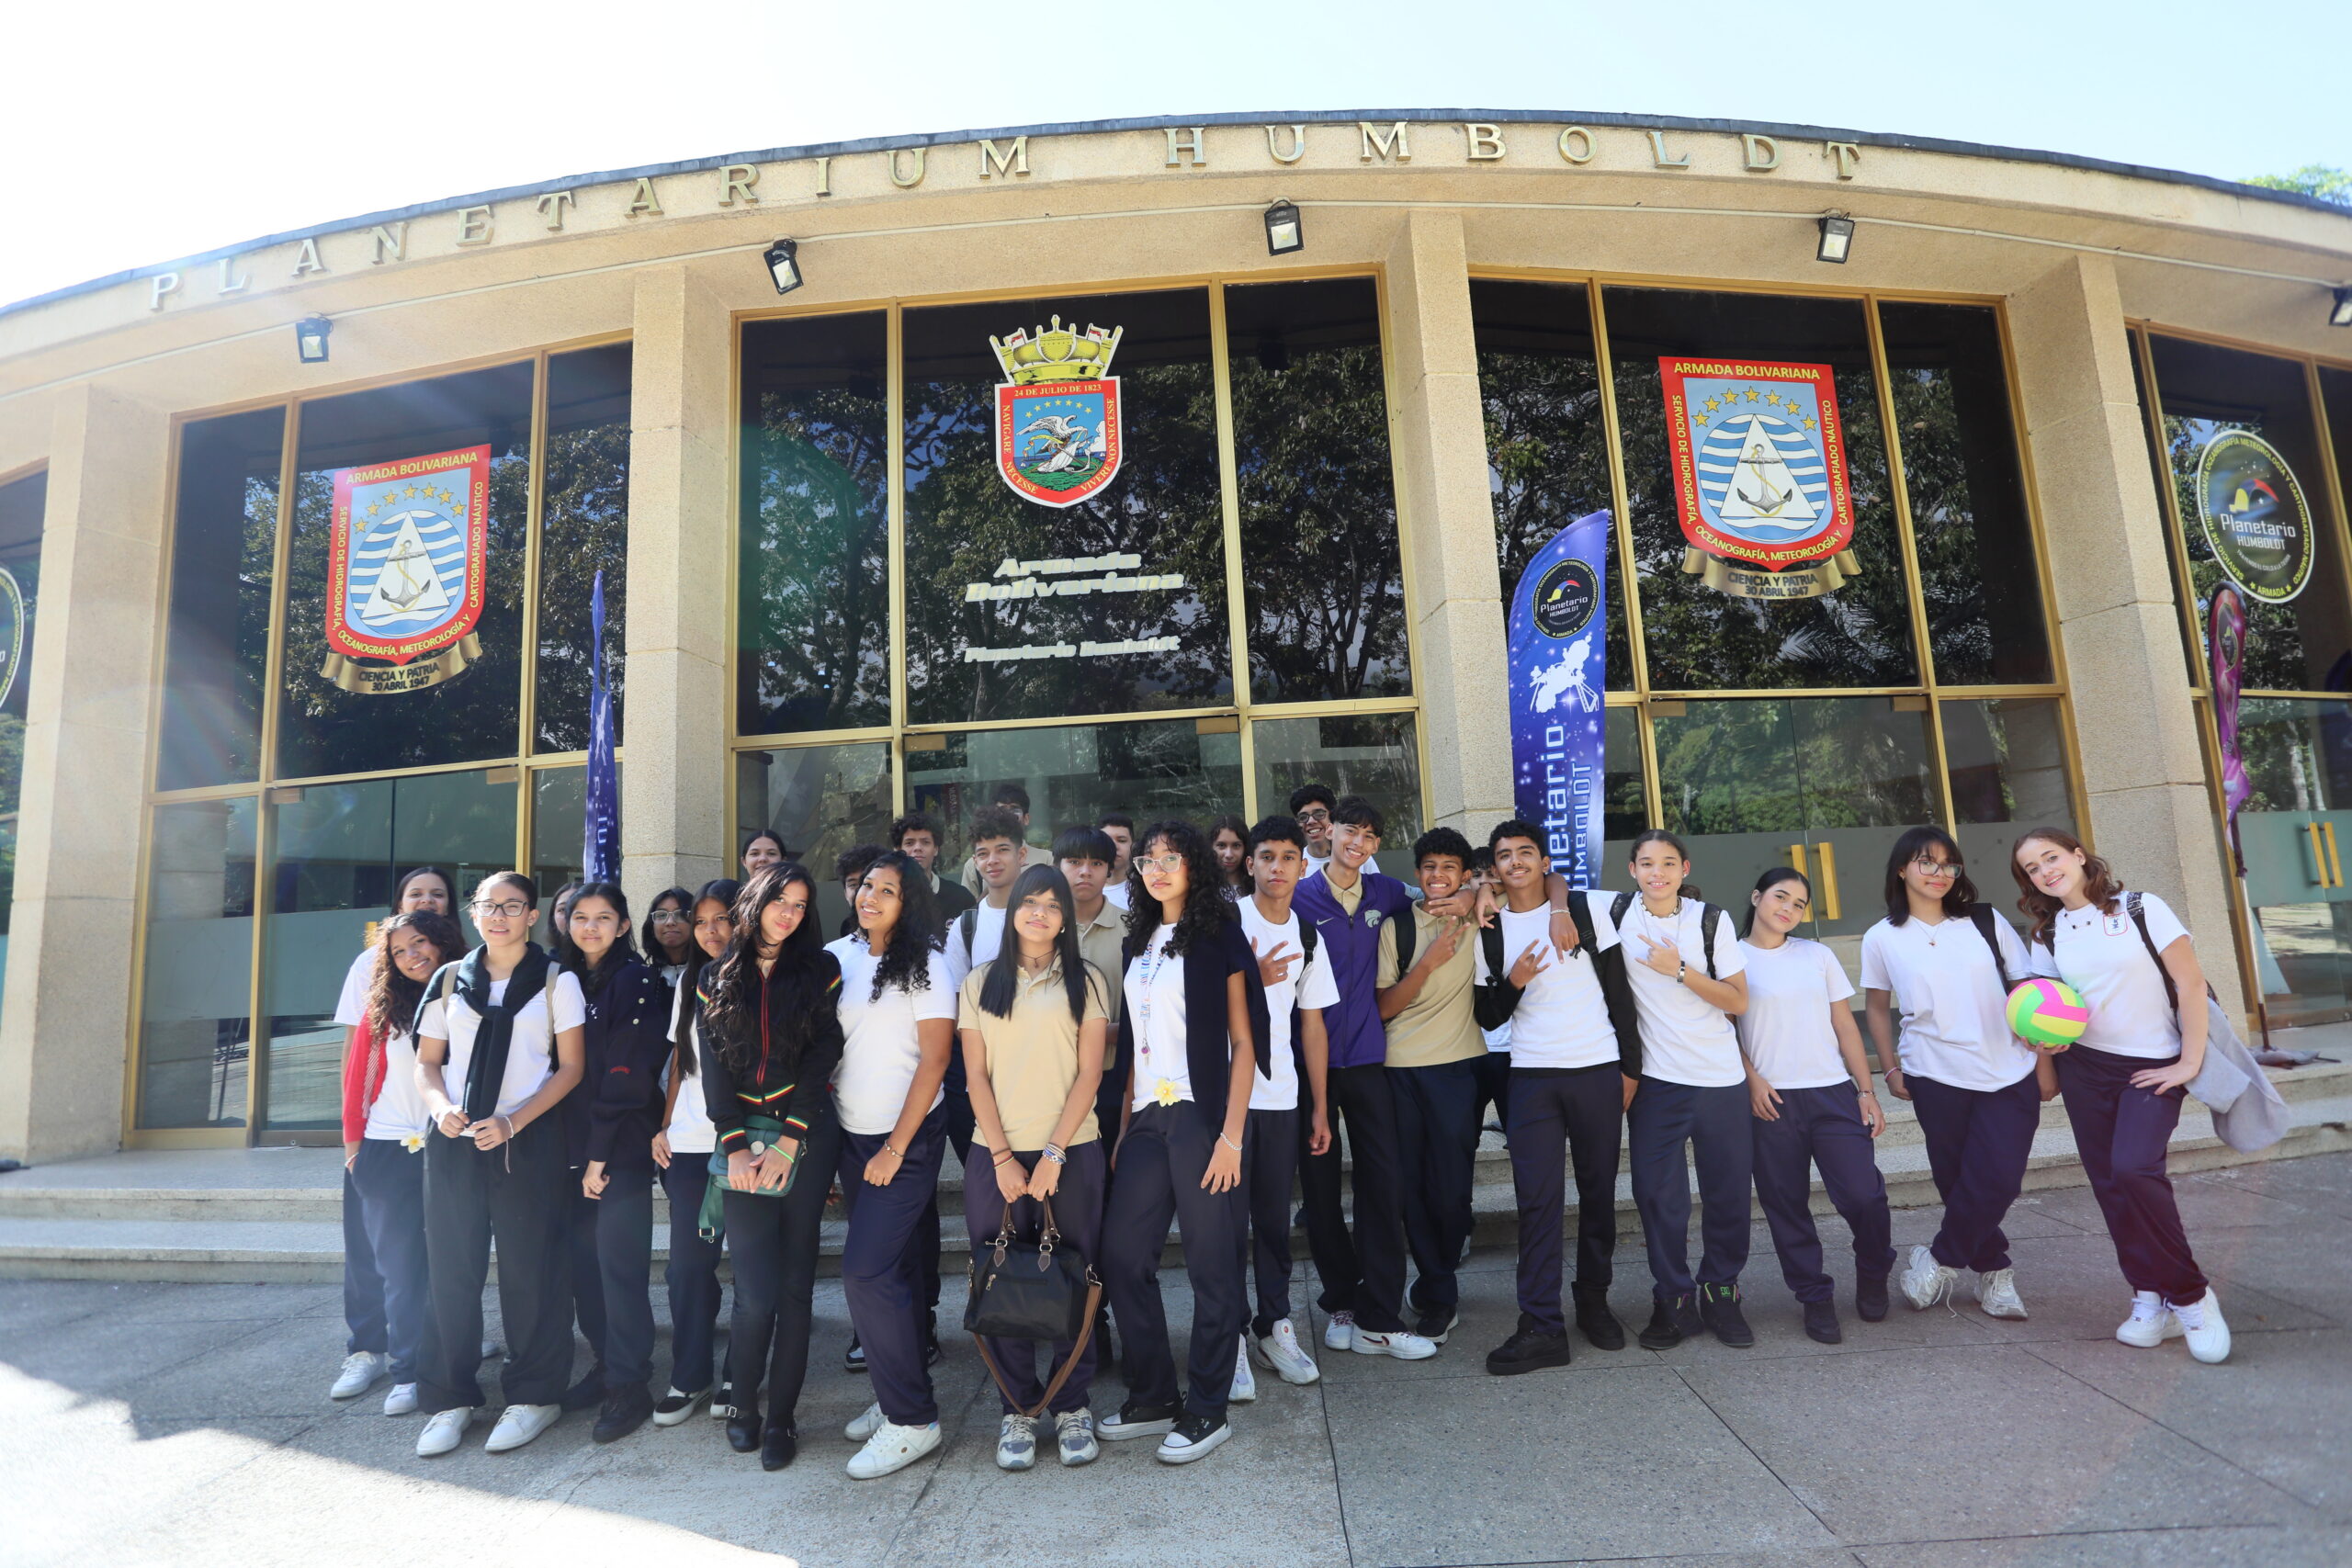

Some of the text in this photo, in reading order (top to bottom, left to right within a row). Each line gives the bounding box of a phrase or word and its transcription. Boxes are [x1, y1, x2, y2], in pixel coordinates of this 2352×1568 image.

[149, 120, 1861, 310] PLANETARIUM HUMBOLDT
[1674, 362, 1820, 379] ARMADA BOLIVARIANA
[1025, 388, 1038, 396] DE
[1040, 385, 1068, 395] JULIO
[1069, 385, 1081, 393] DE
[1084, 383, 1102, 392] 1823
[1002, 404, 1012, 454] NAVIGARE
[1672, 394, 1686, 438] SERVICIO
[1822, 400, 1837, 443] NÁUTICO
[1080, 398, 1117, 491] VIVERE NON NECESSE
[1678, 440, 1689, 453] DE
[346, 451, 478, 485] ARMADA BOLIVARIANA
[1004, 461, 1038, 494] NECESSE
[1829, 445, 1848, 525] CARTOGRAFIADO
[473, 481, 483, 525] NÁUTICO
[337, 506, 347, 548] SERVICIO
[1835, 530, 1843, 539] Y
[2211, 532, 2221, 544] DE
[2220, 513, 2296, 538] Planetario
[337, 549, 345, 561] DE
[1770, 535, 1838, 562] METEOROLOGÍA
[2236, 535, 2286, 551] HUMBOLDT
[469, 525, 482, 608] CARTOGRAFIADO
[2217, 546, 2245, 581] SERVICIO
[1727, 572, 1818, 587] CIENCIA Y PATRIA
[1745, 585, 1809, 597] 30 ABRIL 1947
[2257, 585, 2287, 597] ARMADA
[462, 614, 471, 622] Y
[1540, 596, 1589, 614] Planetario
[1549, 605, 1579, 618] HUMBOLDT
[400, 621, 466, 655] METEOROLOGÍA
[358, 661, 440, 682] CIENCIA Y PATRIA
[372, 675, 431, 692] 30 ABRIL 1947
[1540, 725, 1571, 881] netario
[1572, 762, 1592, 890] UMBOLDT
